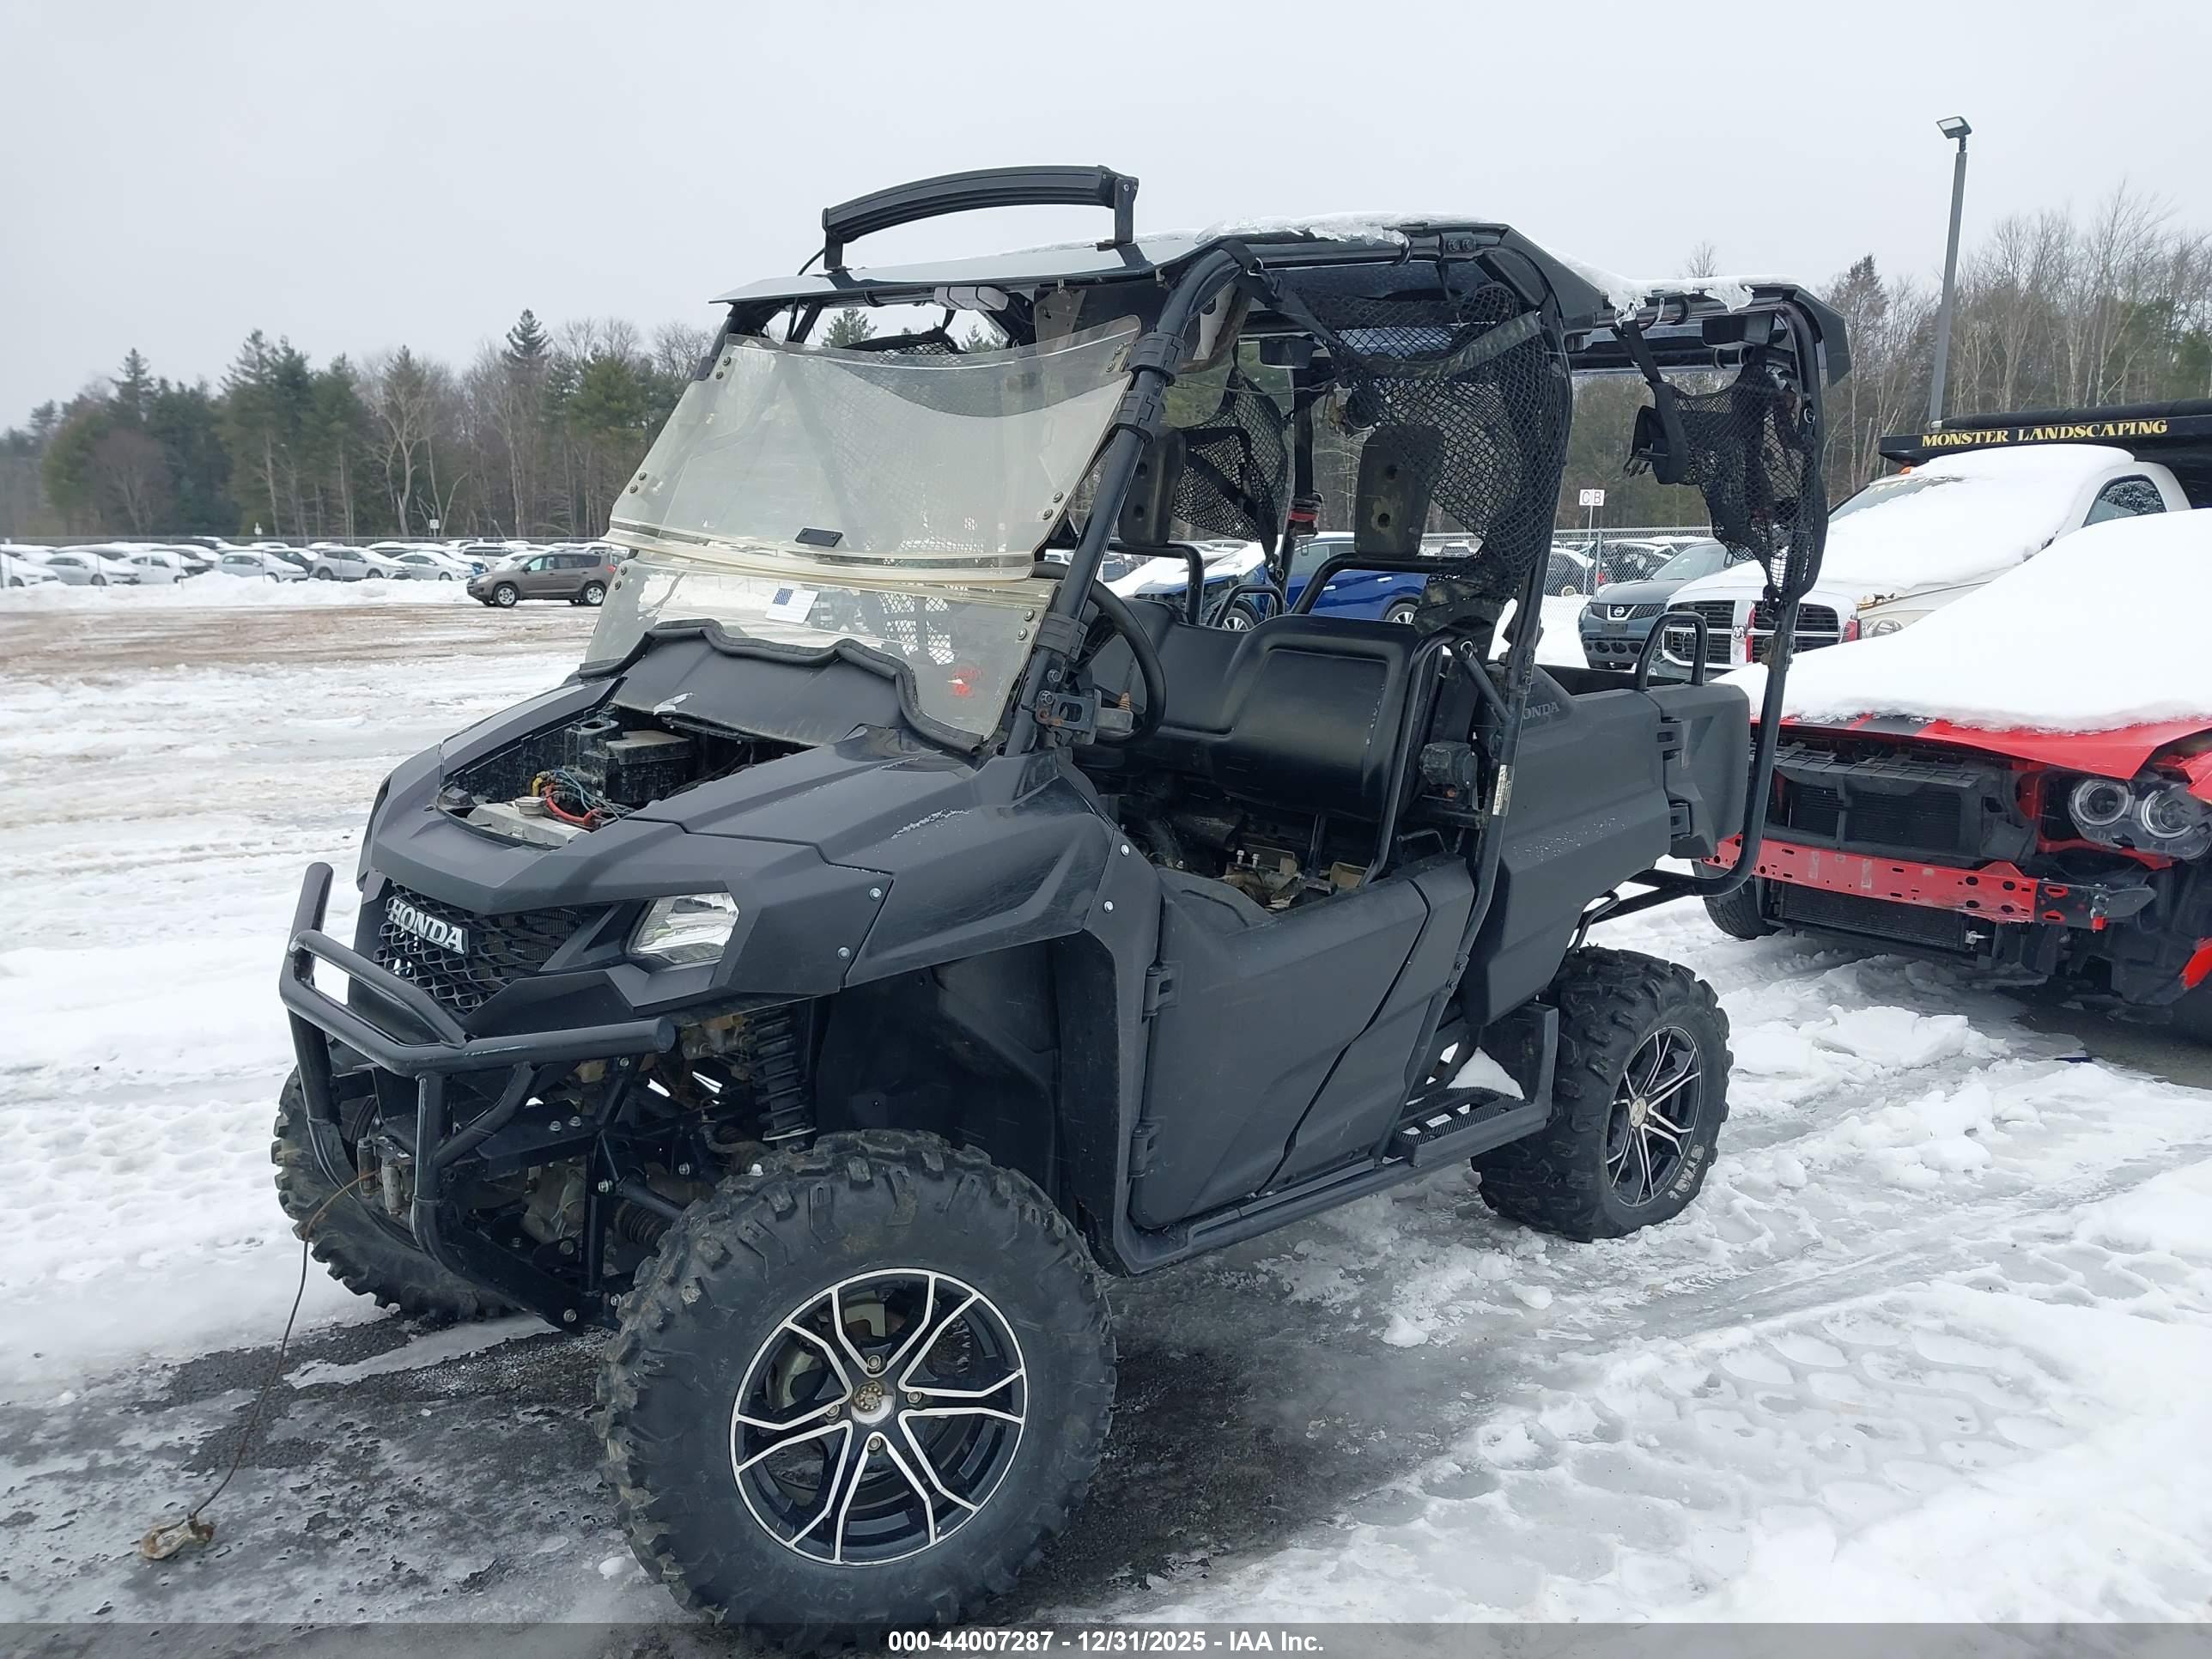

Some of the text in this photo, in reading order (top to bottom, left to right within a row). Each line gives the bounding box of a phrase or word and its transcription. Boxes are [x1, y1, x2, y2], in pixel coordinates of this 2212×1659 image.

[1922, 420, 2168, 447] MONSTER LANDSCAPING
[1522, 701, 1560, 720] ONDA
[387, 898, 465, 954] HONDA
